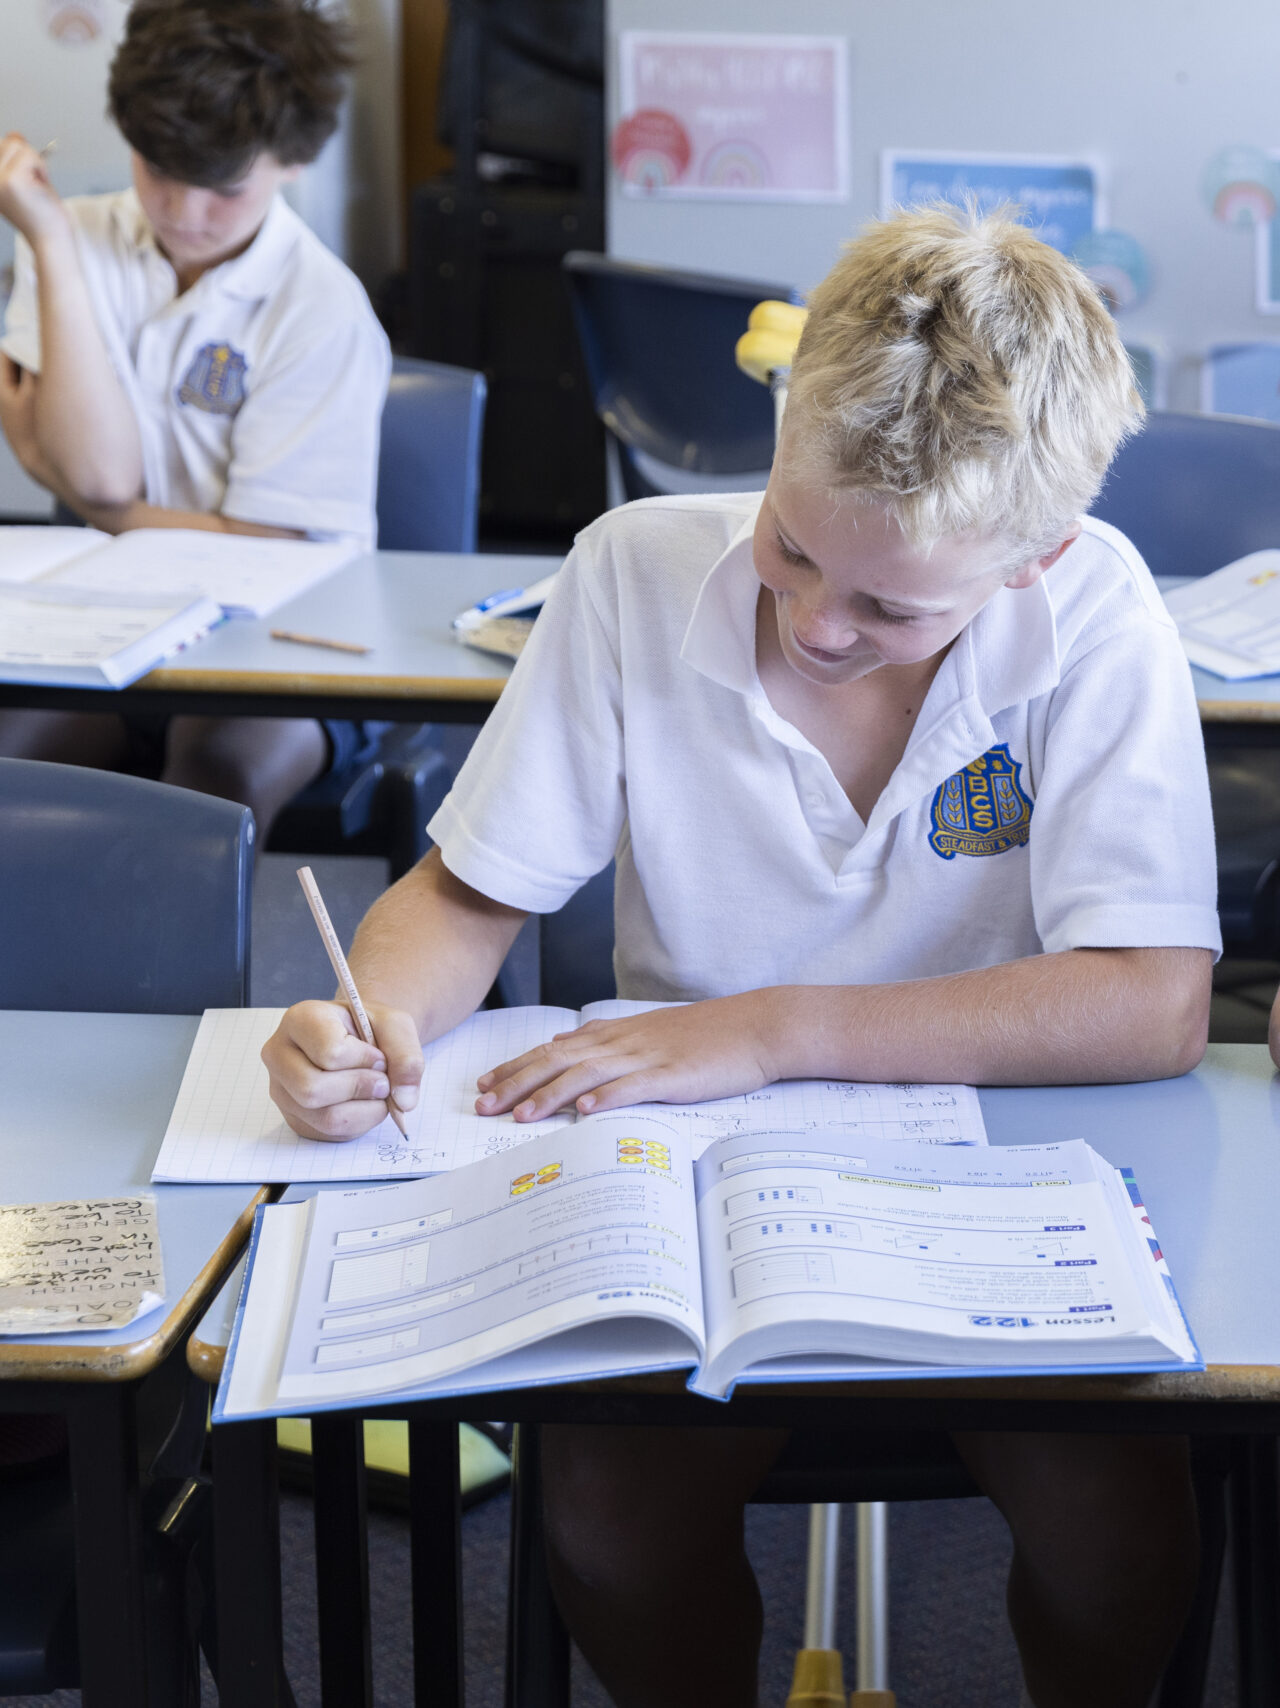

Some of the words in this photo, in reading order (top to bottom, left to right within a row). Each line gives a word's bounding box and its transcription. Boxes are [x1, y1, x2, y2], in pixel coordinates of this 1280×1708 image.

[968, 775, 994, 828] BCS
[940, 836, 997, 852] STEADFAST
[9, 1253, 152, 1268] MATHEMA
[44, 1299, 144, 1313] OALS
[968, 1315, 1038, 1328] 122
[1045, 1316, 1115, 1325] Lesson
